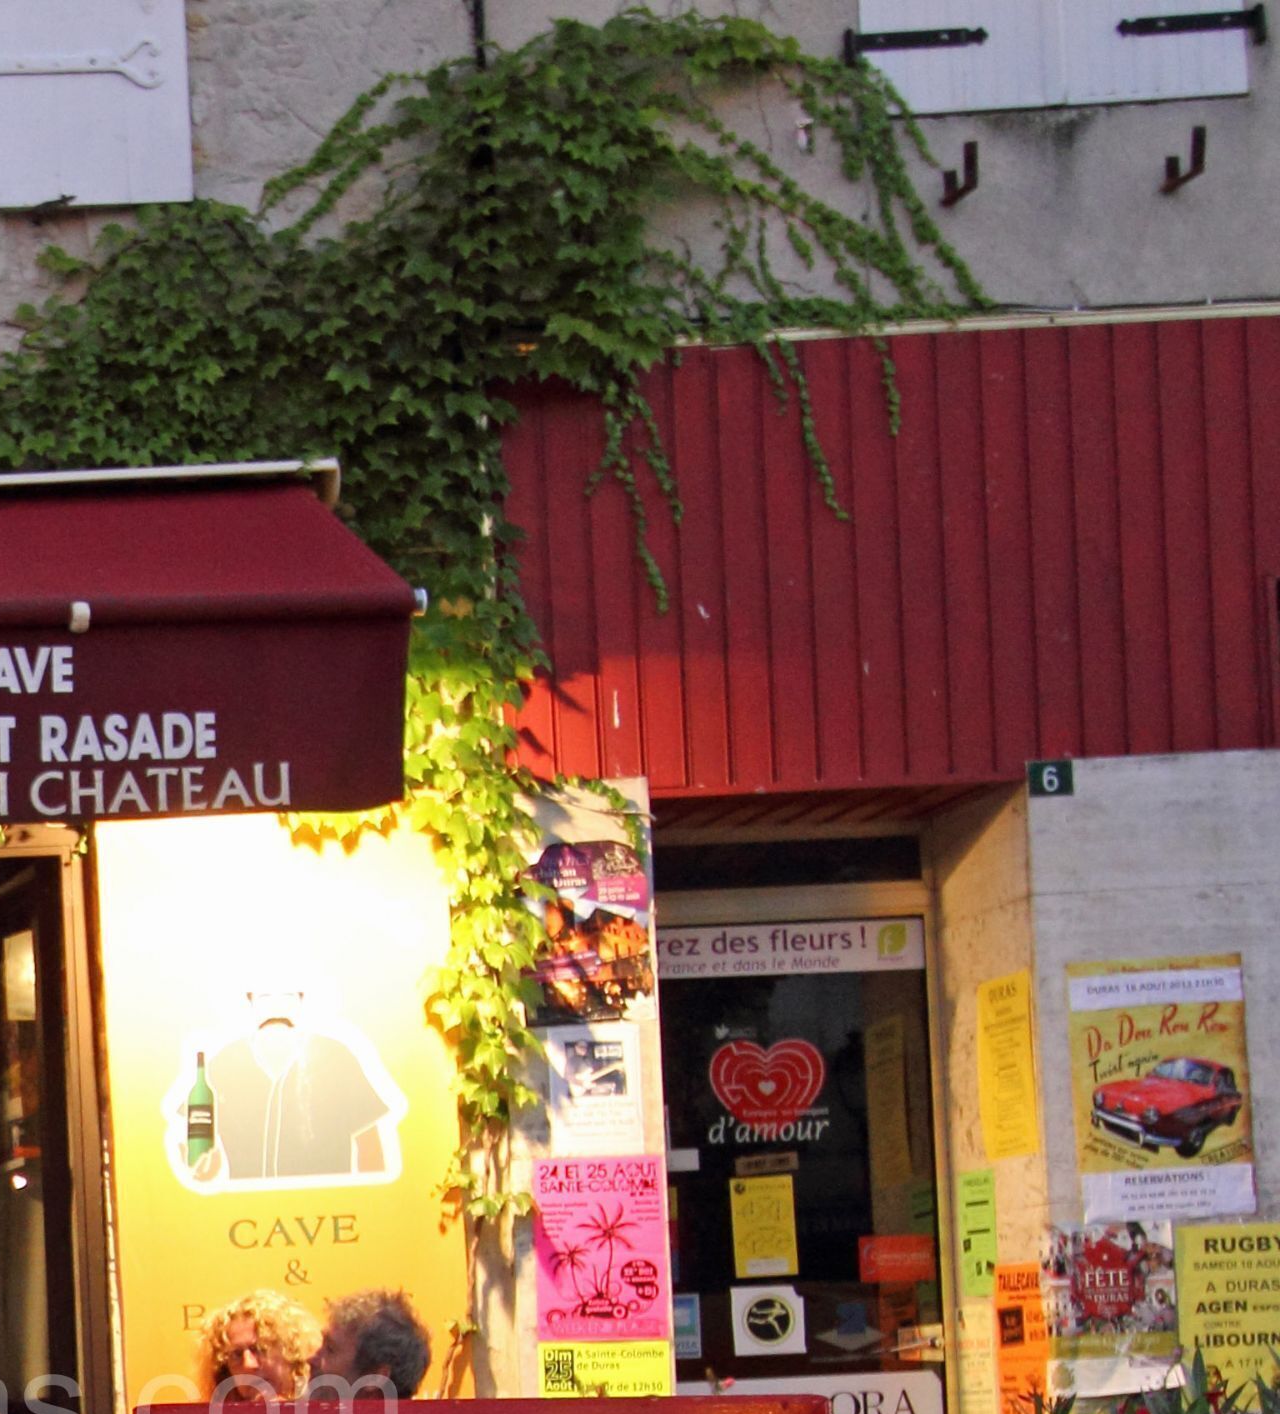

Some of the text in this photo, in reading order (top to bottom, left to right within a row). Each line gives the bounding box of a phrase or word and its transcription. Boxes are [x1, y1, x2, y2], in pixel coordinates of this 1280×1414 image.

[41, 712, 217, 762] RASADE
[30, 763, 291, 816] CHATEAU
[1041, 766, 1059, 793] 6
[658, 938, 700, 956] rez
[711, 932, 758, 954] des
[771, 929, 852, 951] fleurs
[712, 959, 727, 972] et
[733, 957, 767, 971] dans
[772, 957, 786, 970] le
[791, 955, 840, 969] Monde
[1085, 1026, 1113, 1060] Da
[708, 1116, 830, 1144] d'amour
[540, 1163, 657, 1180] 24 ET 25 AOUT
[229, 1215, 360, 1250] CAVE
[1204, 1236, 1280, 1253] RUGBY
[284, 1259, 311, 1285] &
[1194, 1260, 1237, 1271] SAMEDI
[1084, 1267, 1129, 1288] FÊTE
[1206, 1279, 1280, 1293] A DURAS
[1196, 1300, 1248, 1314] AGEN
[1194, 1333, 1280, 1349] LIBOURN
[545, 1350, 571, 1361] Dim
[1225, 1359, 1234, 1368] A
[546, 1361, 572, 1381] 25
